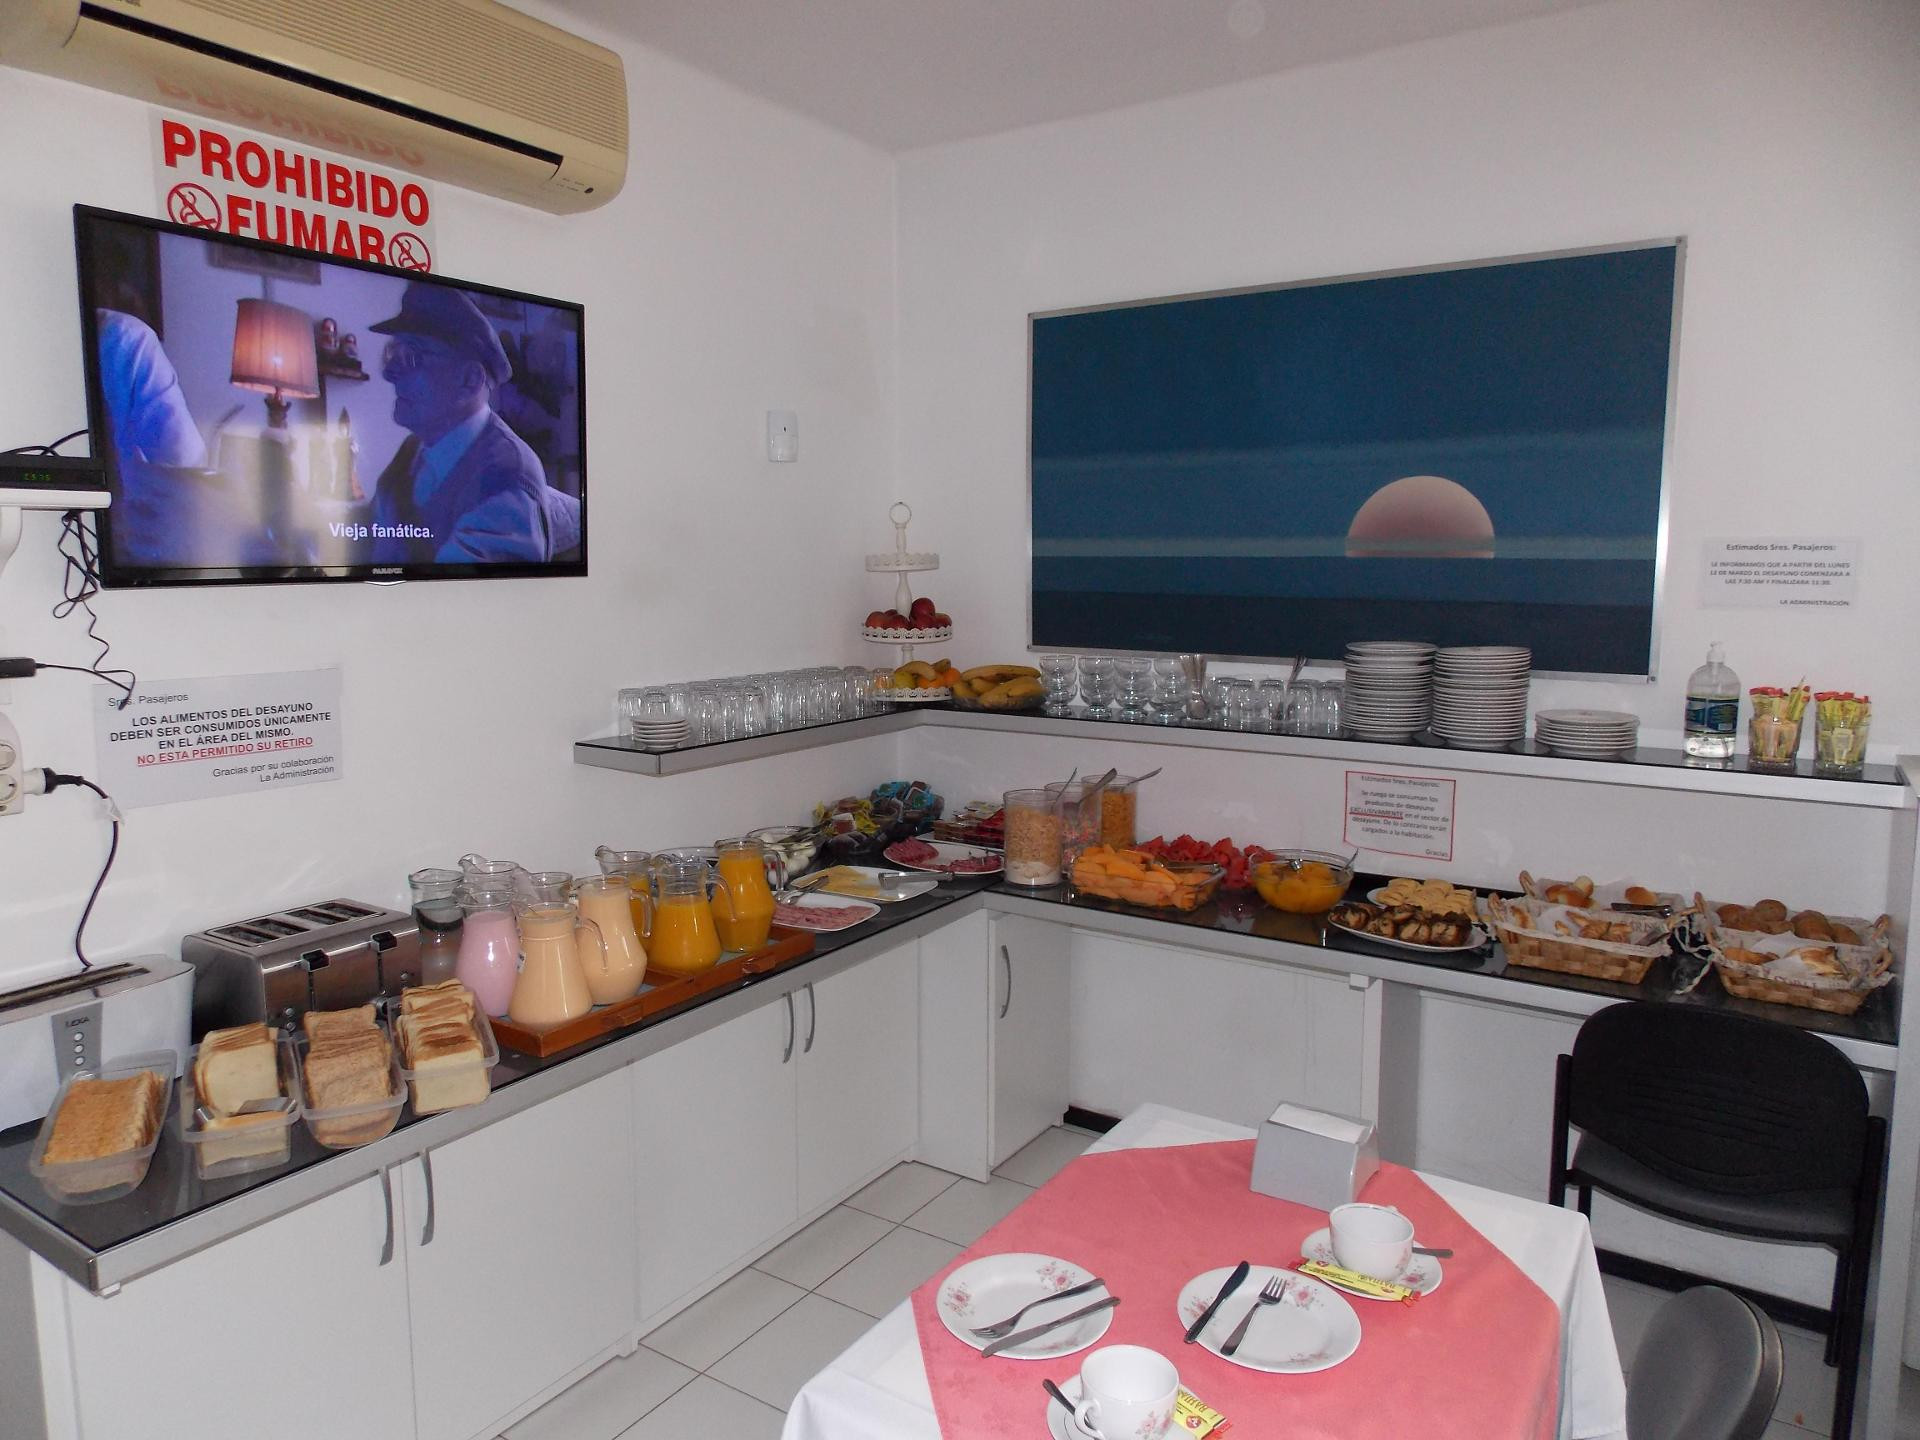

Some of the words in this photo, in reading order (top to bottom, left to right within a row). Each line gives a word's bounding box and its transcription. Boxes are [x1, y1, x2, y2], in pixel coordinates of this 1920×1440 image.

[162, 119, 430, 226] PROHIBIDO
[226, 193, 387, 266] FUMAR
[329, 522, 368, 541] Vieja
[372, 523, 434, 538] fanática.
[108, 696, 135, 708] Srs.
[138, 692, 189, 705] Pasajeros
[132, 716, 157, 727] LOS
[160, 710, 228, 725] ALIMENTOS
[231, 707, 253, 718] DEL
[256, 702, 313, 716] DESAYUNO
[110, 729, 152, 742] DEBEN
[157, 726, 181, 738] SER
[184, 718, 261, 734] CONSUMIDOS
[159, 740, 175, 750] EN
[178, 737, 193, 748] EL
[196, 733, 228, 746] ÁREA
[231, 731, 253, 742] DEL
[256, 727, 294, 740] MISMO.
[137, 754, 156, 765] NO
[159, 751, 189, 763] ESTA
[193, 743, 254, 759] PERMITIDO
[256, 740, 272, 752] SU
[275, 736, 313, 749] RETIRO
[213, 766, 249, 778] Gracias
[251, 764, 266, 775] por
[268, 762, 279, 772] su
[281, 754, 334, 769] colaboración
[260, 772, 272, 783] La
[273, 765, 335, 781] Administración
